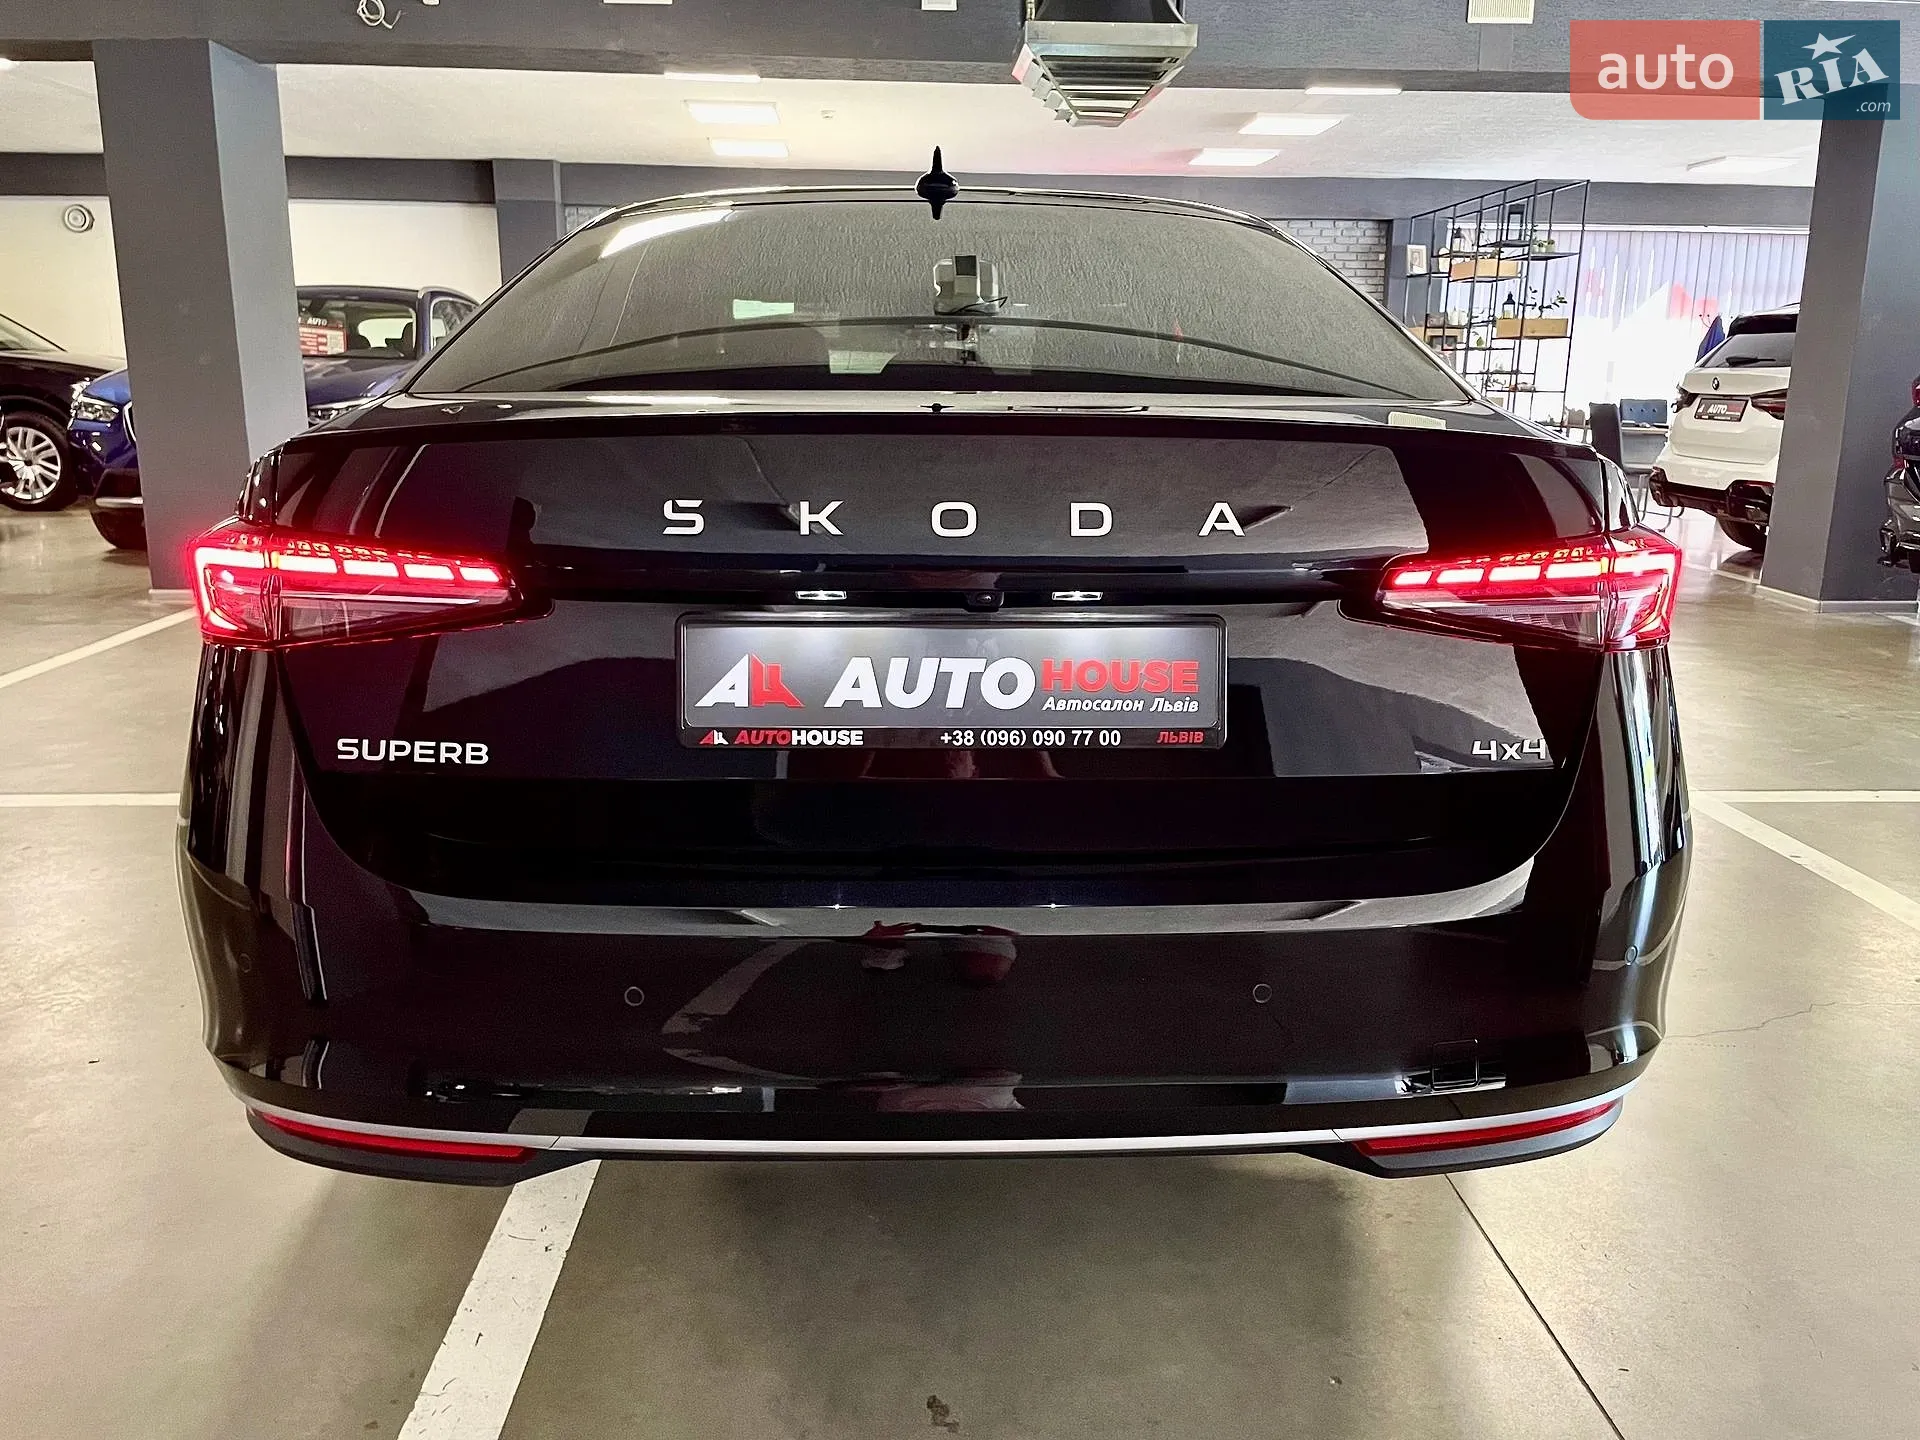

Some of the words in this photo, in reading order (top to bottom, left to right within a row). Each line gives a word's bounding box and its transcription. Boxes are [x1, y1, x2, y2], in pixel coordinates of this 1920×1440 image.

[1707, 404, 1728, 415] AUTO
[823, 656, 1036, 710] AUTO
[1040, 658, 1199, 694] HOUSE
[1042, 696, 1144, 712] Автосалон
[1149, 697, 1199, 713] Львів
[734, 729, 864, 746] AUTOHOUSE
[940, 730, 975, 747] +38
[980, 730, 1027, 747] (096)
[1032, 730, 1066, 747] 090
[1071, 730, 1094, 746] 77
[1099, 730, 1122, 746] 00
[1156, 731, 1205, 745] ЛЬВІВ
[336, 738, 489, 765] SUPERB
[1472, 739, 1547, 761] 4x4
